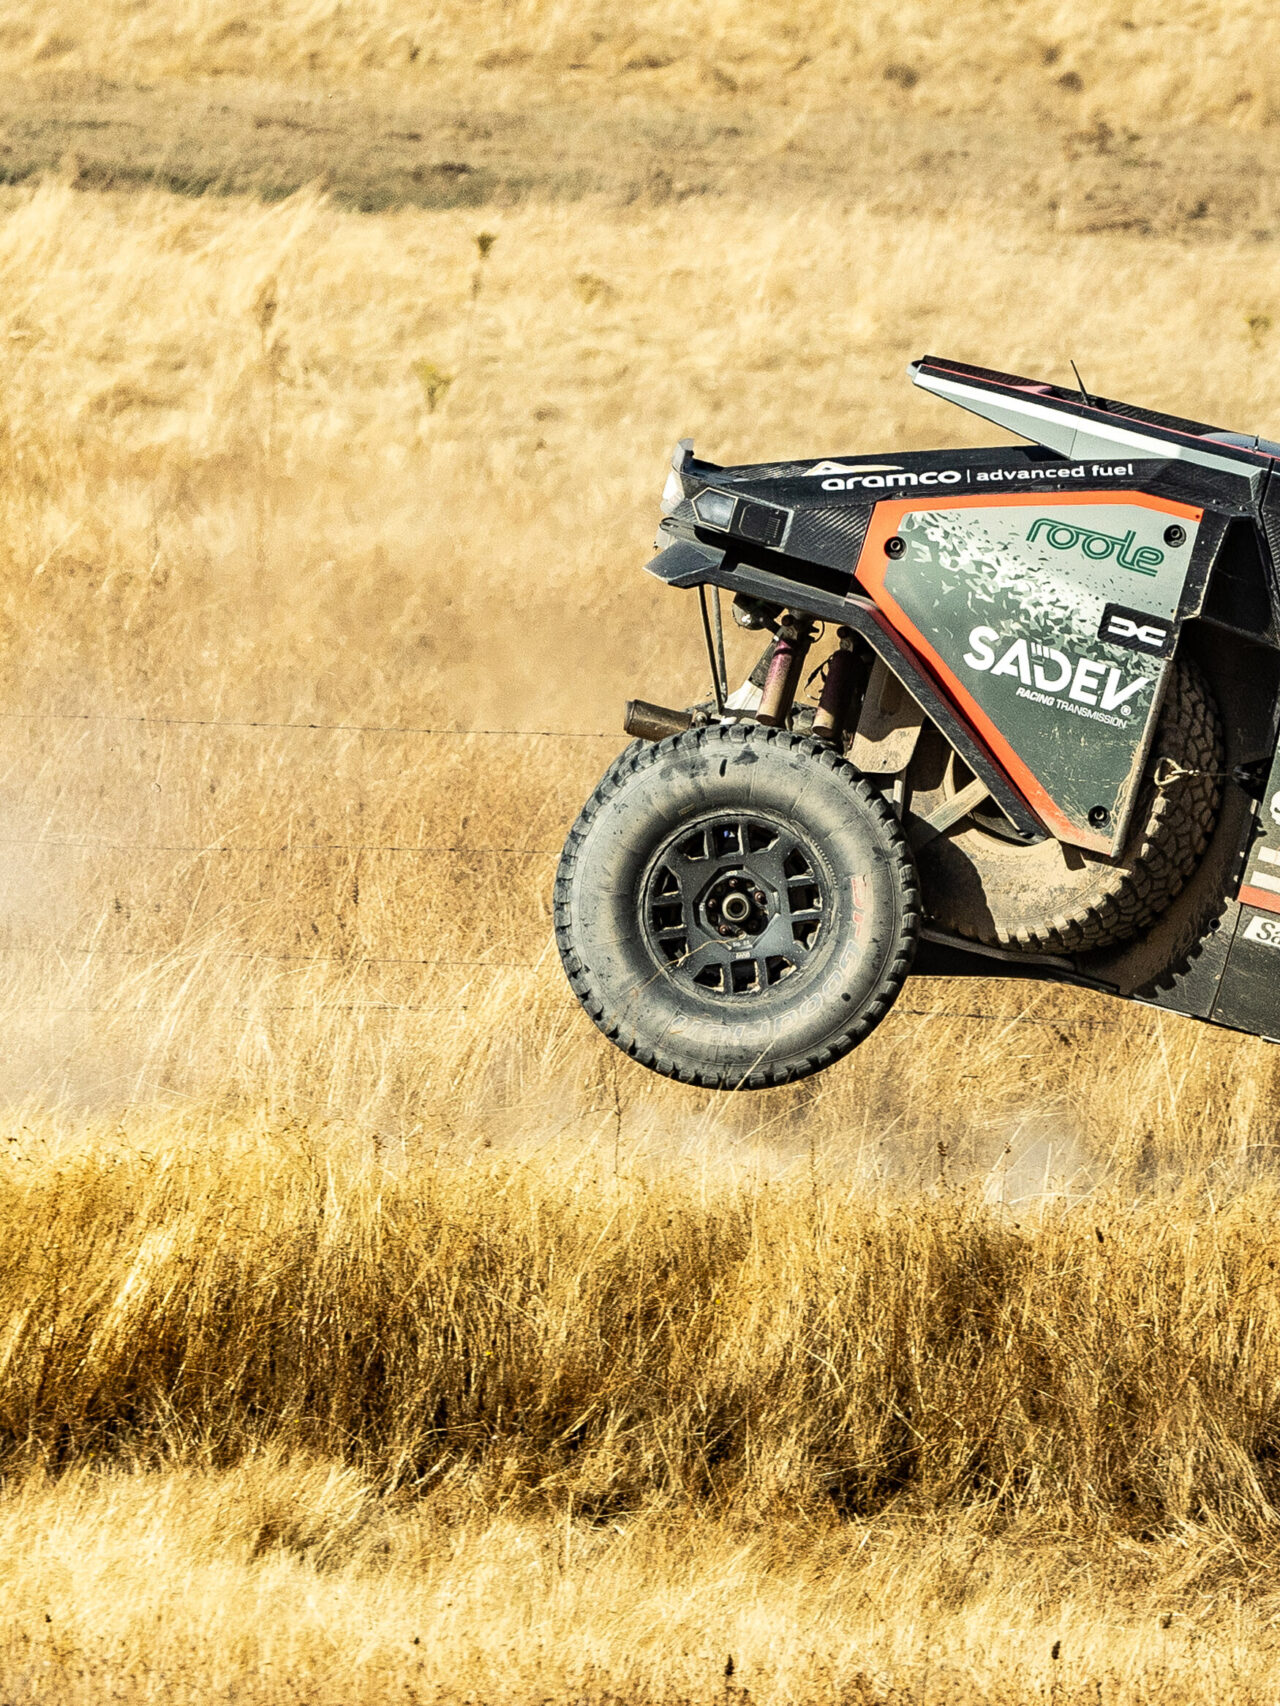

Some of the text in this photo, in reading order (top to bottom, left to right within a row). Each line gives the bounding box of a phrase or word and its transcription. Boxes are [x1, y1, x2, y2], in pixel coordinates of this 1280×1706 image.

[820, 463, 1134, 491] aramco advanced fuel
[1025, 517, 1165, 577] roole
[962, 625, 1151, 712] SADEV
[1016, 686, 1128, 729] RACING TRANSMISSION
